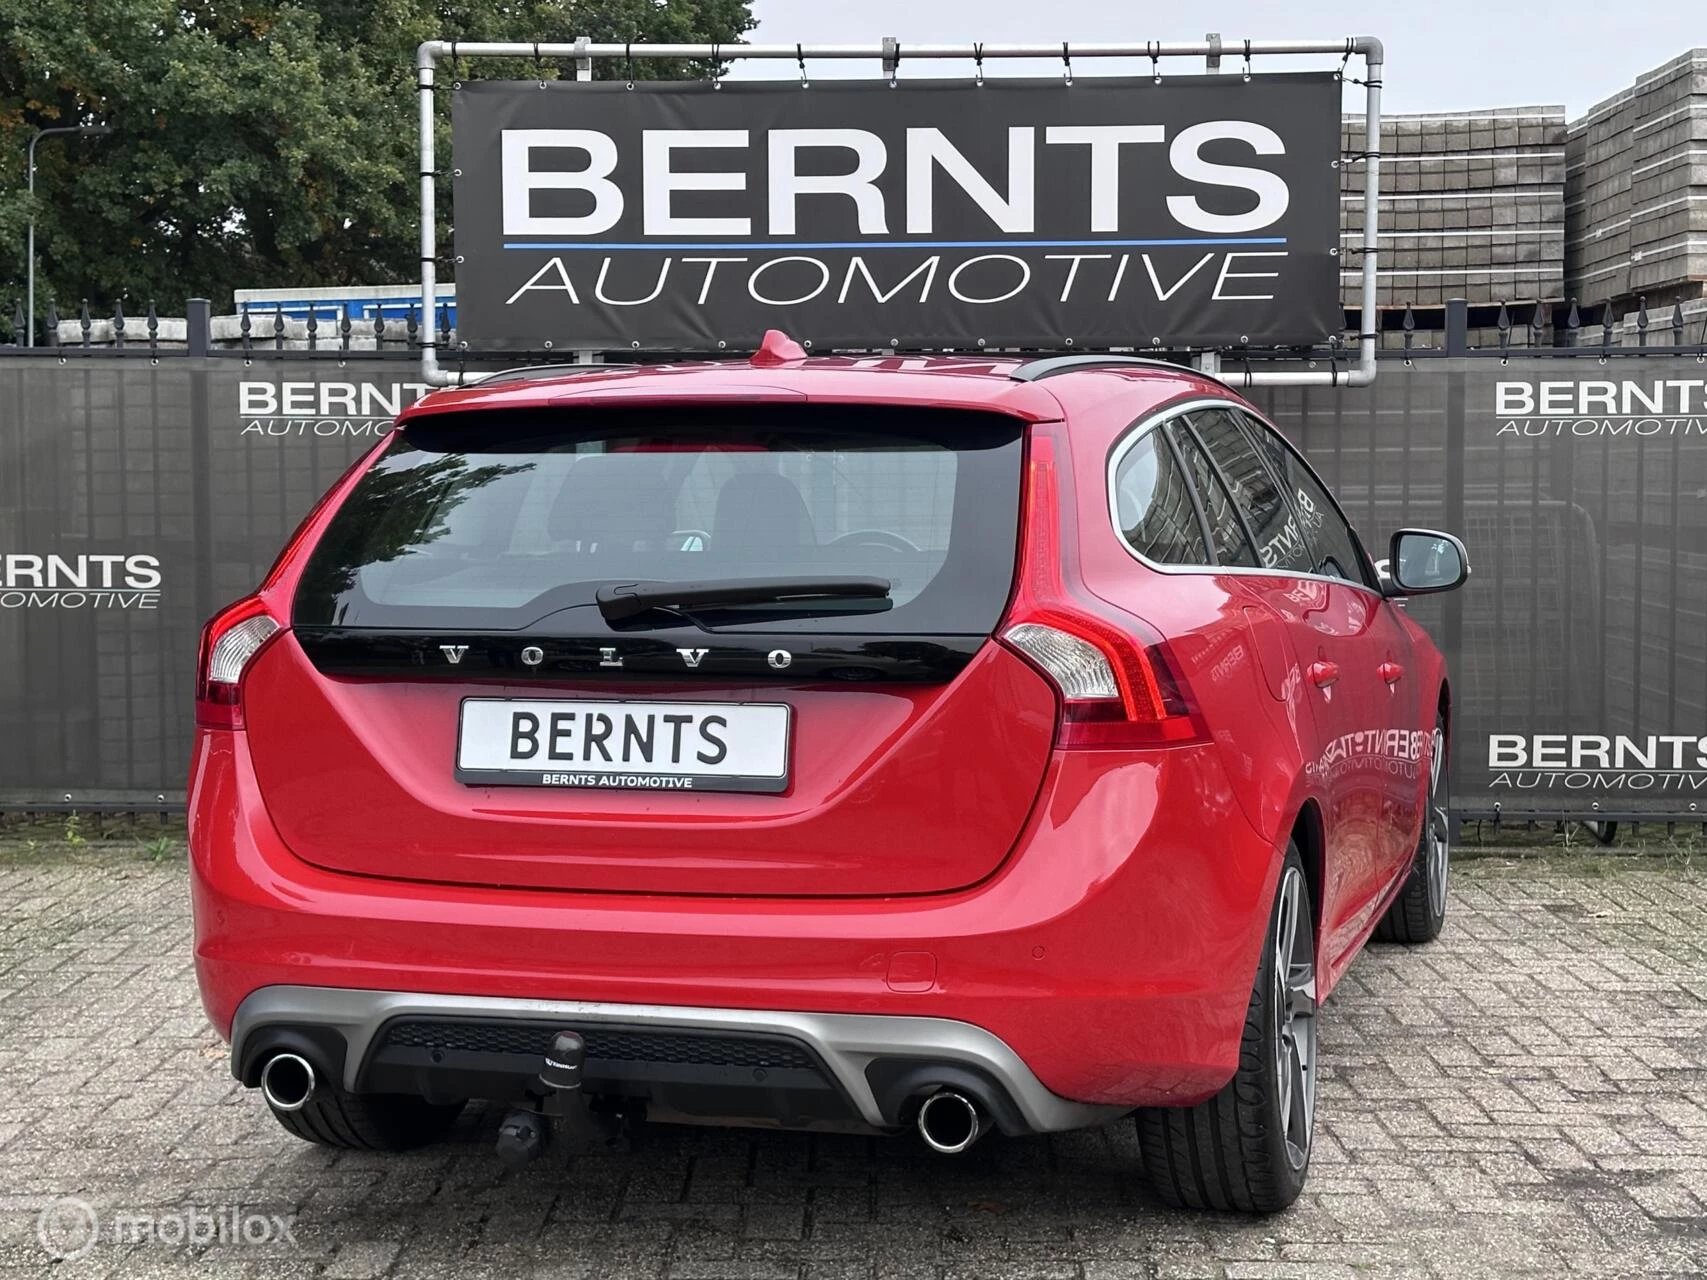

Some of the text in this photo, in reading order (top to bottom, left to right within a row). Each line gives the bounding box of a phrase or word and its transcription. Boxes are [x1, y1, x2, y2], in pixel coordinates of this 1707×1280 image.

[501, 120, 1290, 236] BERNTS
[506, 251, 1289, 305] AUTOMOTIVE
[239, 381, 452, 415] BERNT
[1495, 379, 1707, 414] BERNT
[0, 554, 162, 589] RNTS
[439, 644, 792, 669] VOLVO
[509, 711, 727, 765] BERNTS
[1488, 734, 1707, 769] BERNT
[542, 773, 693, 789] BERNTS AUTOMOTIVE
